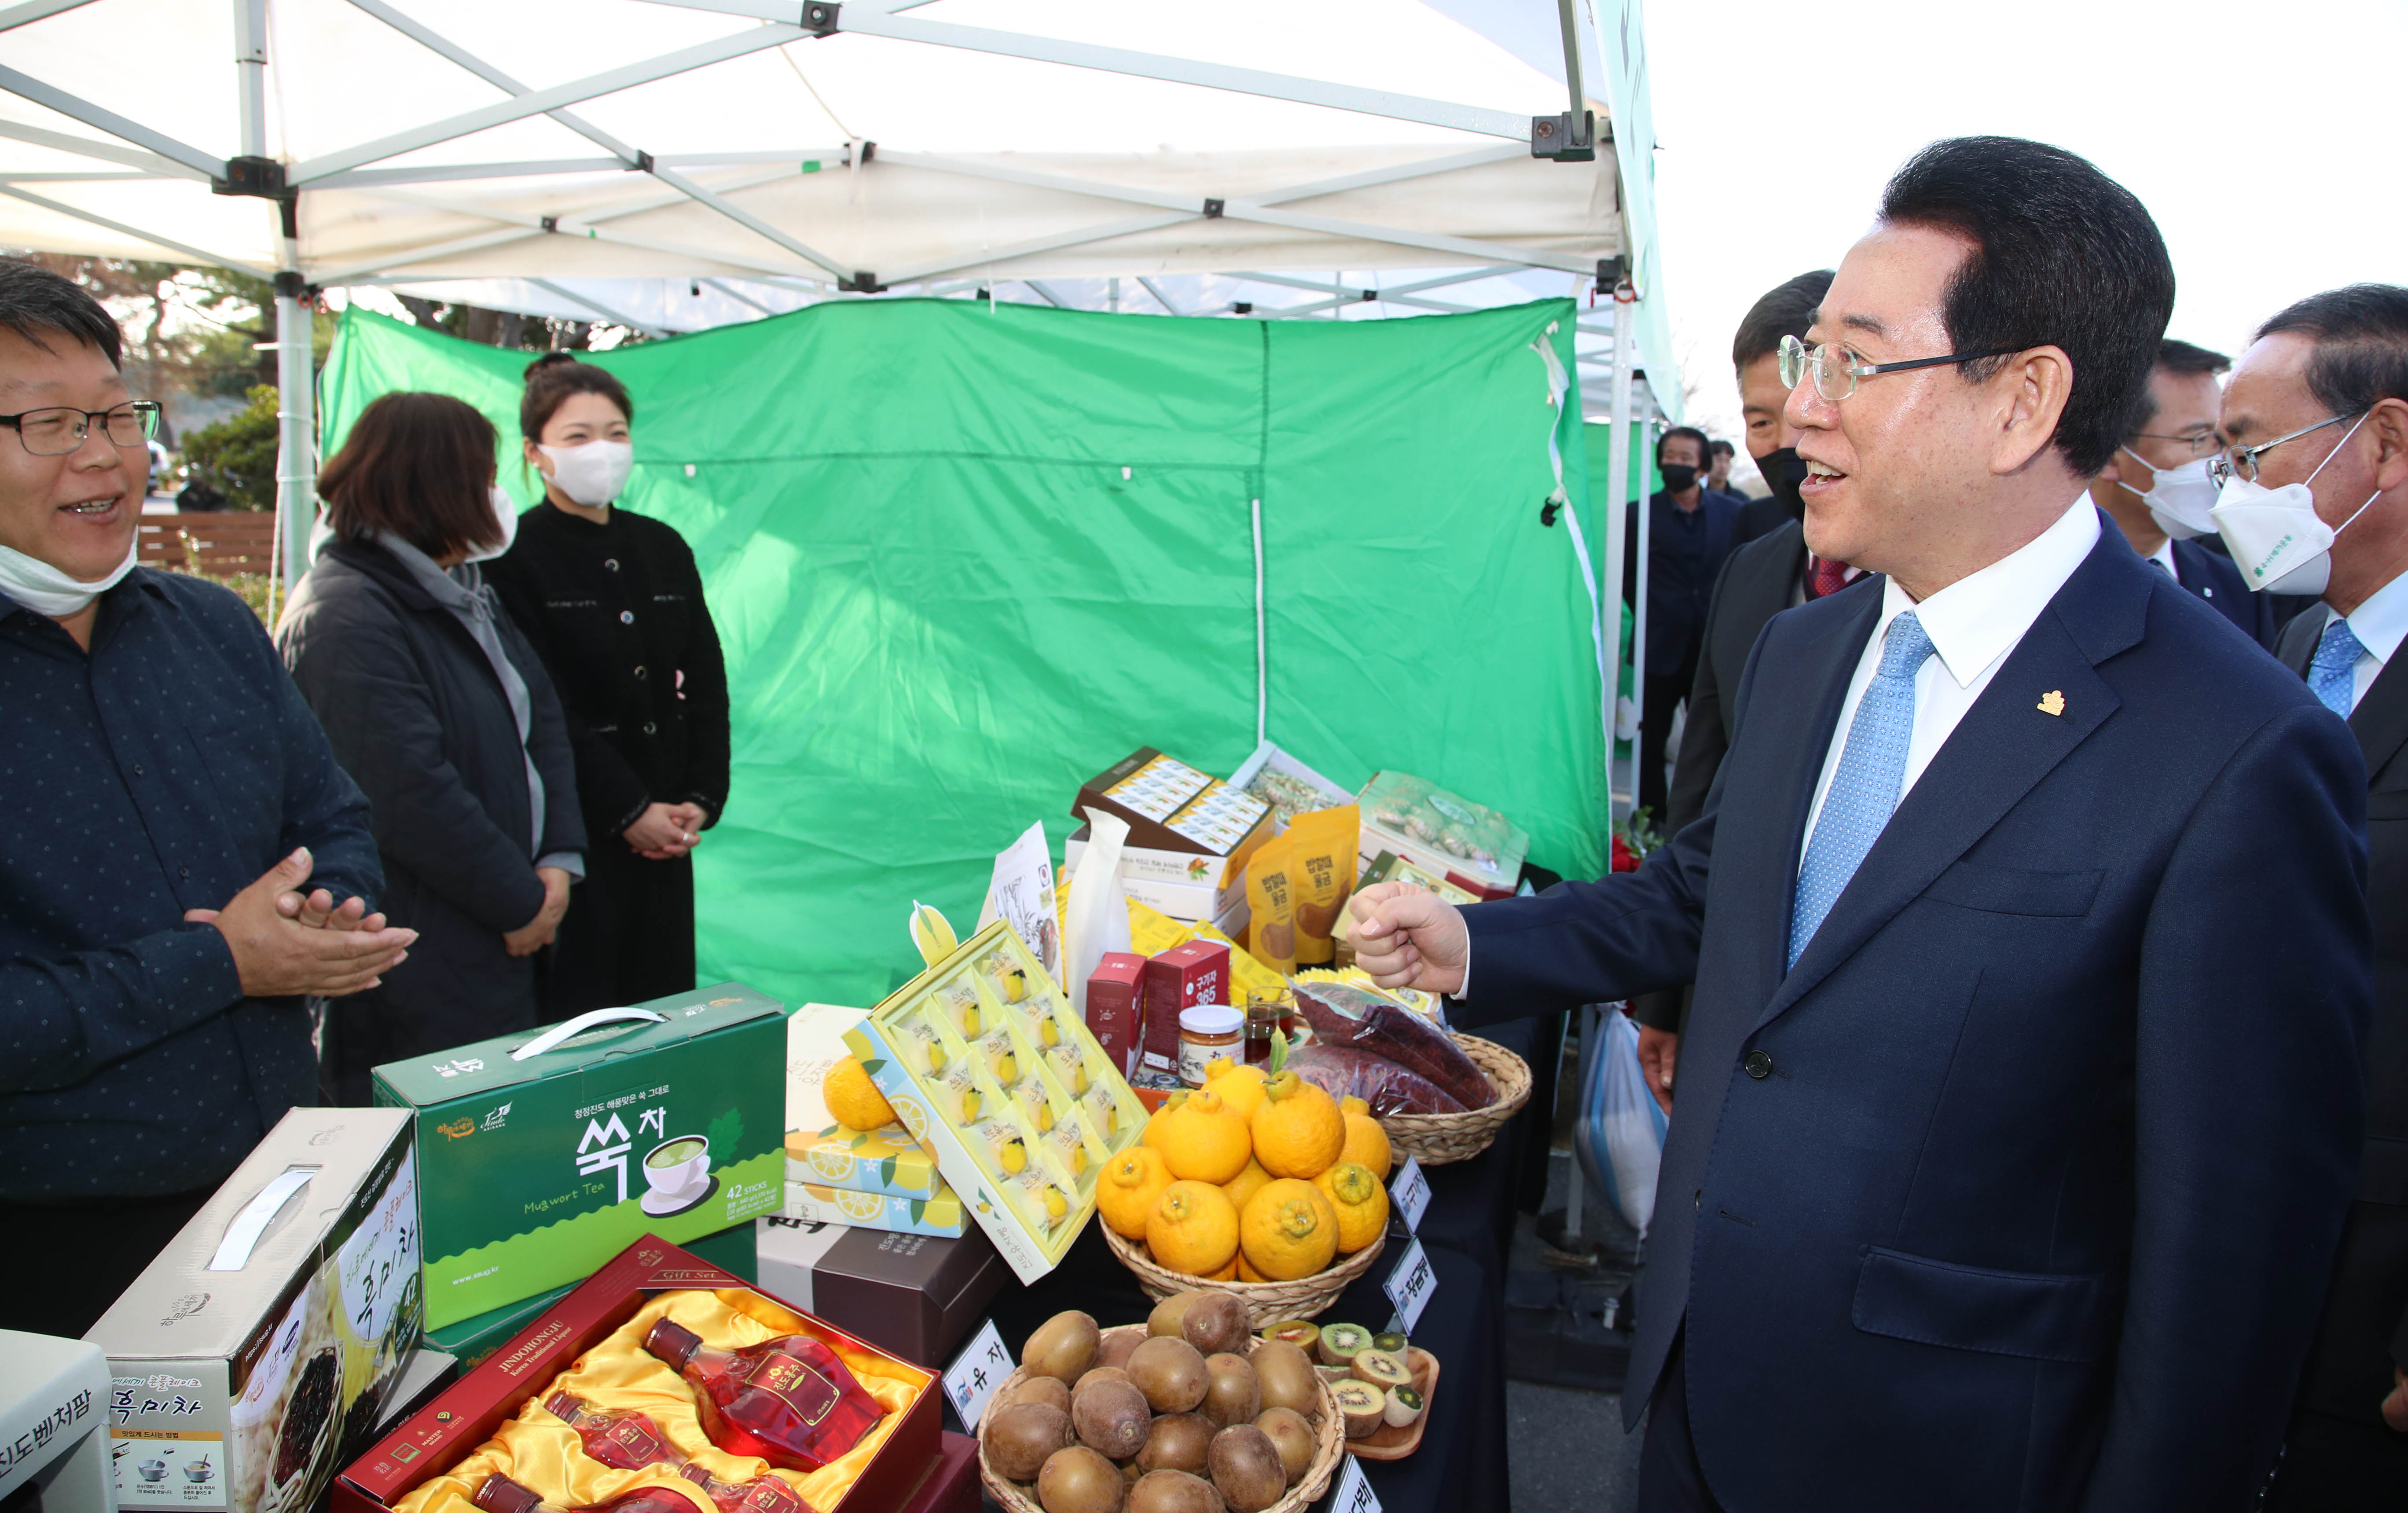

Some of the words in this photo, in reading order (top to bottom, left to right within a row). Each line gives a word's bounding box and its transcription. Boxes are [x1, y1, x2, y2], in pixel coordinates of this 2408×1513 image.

[1197, 969, 1217, 990] 구기자
[1196, 986, 1216, 1006] 365
[575, 1103, 605, 1119] 청정진도
[607, 1094, 636, 1109] 해풍맞은
[639, 1091, 646, 1100] 쑥
[647, 1084, 669, 1098] 그대로
[525, 1190, 578, 1214] Mugwort
[582, 1182, 605, 1195] Tea
[726, 1184, 742, 1200] 42
[744, 1181, 767, 1195] STICKS
[452, 1266, 500, 1285] www.ssug.kr
[663, 1271, 690, 1280] Gift
[499, 1320, 563, 1373] JINDOHONGJU
[510, 1362, 529, 1377] Korea
[526, 1340, 556, 1363] Traditional
[554, 1326, 572, 1342] Liquor
[149, 1375, 202, 1390] 콘플레이크
[773, 1364, 801, 1390] 진도홍주
[111, 1390, 202, 1425] 흑미차
[422, 1430, 443, 1446] MASTER
[429, 1435, 443, 1446] BRAND
